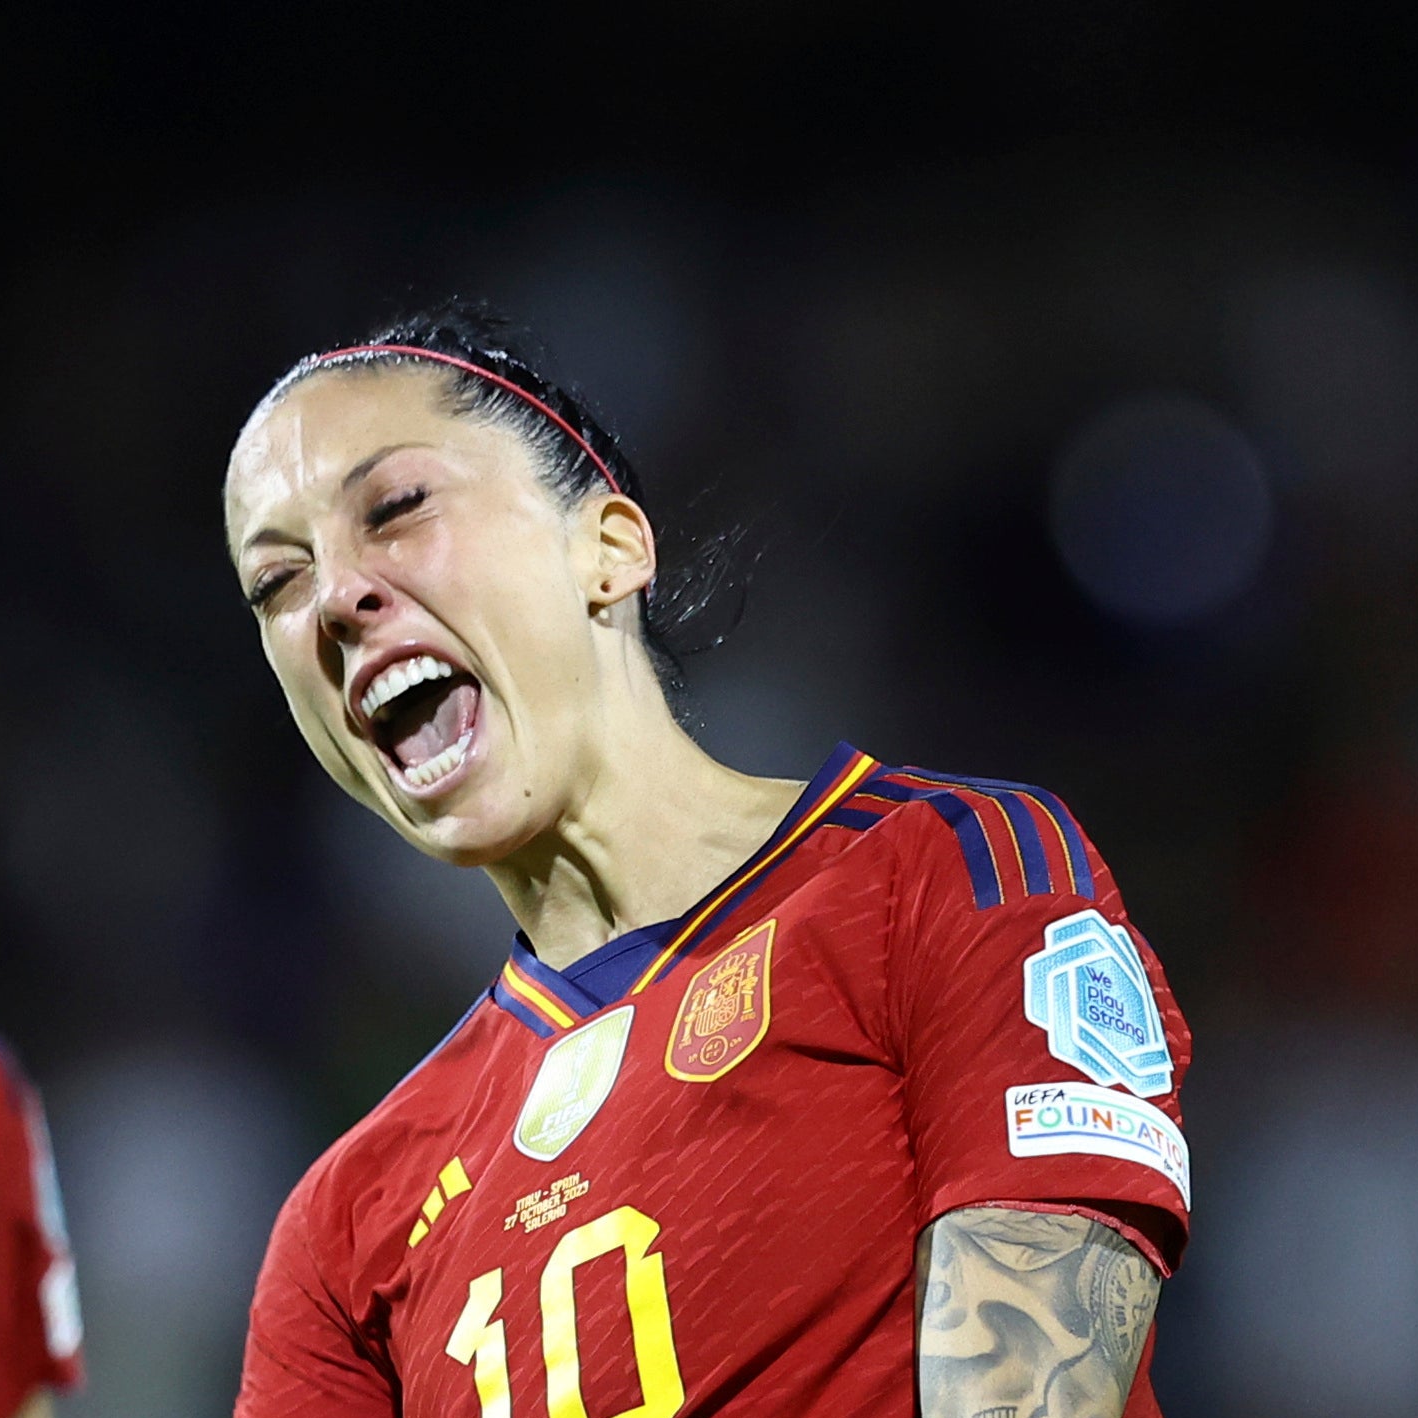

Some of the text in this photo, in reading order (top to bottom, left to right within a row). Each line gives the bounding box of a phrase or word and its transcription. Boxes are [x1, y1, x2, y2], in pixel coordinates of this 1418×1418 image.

[1086, 965, 1112, 989] We
[1088, 986, 1124, 1018] Play
[1089, 1005, 1145, 1046] Strong
[1014, 1087, 1067, 1106] UEFA
[503, 1180, 590, 1232] 27 OCTOBER 2023
[515, 1189, 542, 1213] ITALY
[550, 1172, 581, 1196] SPAIN
[524, 1203, 568, 1233] SALERNO
